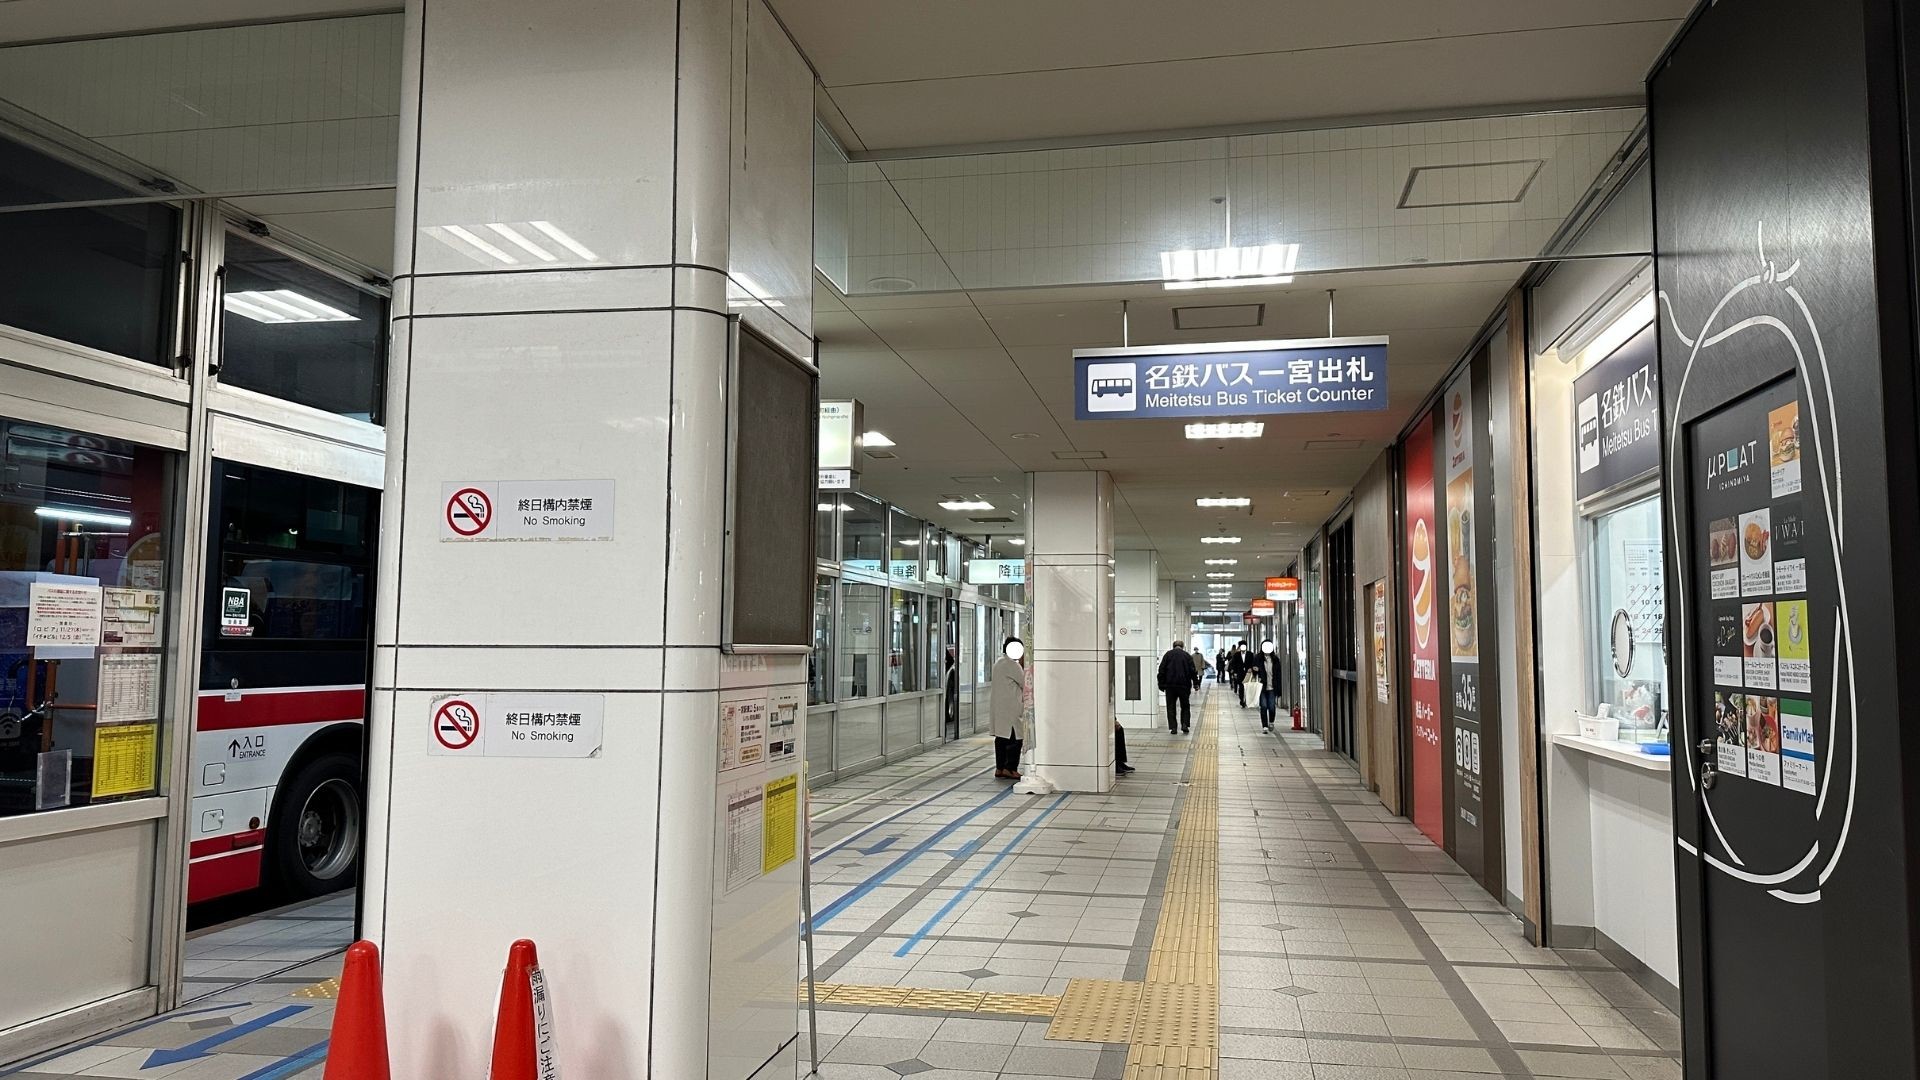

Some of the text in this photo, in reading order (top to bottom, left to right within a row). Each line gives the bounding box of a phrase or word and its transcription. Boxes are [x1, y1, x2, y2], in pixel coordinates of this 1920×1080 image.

[1145, 386, 1374, 408] Meitetsu Bus Ticket Counter
[1601, 364, 1657, 429] 名鉄バス
[1602, 425, 1633, 457] Meitetsu
[1634, 418, 1650, 442] Bus
[1719, 475, 1750, 491] ICHINOMIYA
[518, 498, 593, 512] 終日構内禁煙
[523, 515, 586, 527] No Smoking
[998, 564, 1025, 578] 降車
[228, 596, 245, 607] NBA
[505, 712, 581, 726] 終日構内禁煙
[511, 731, 574, 744] No Smoking
[1782, 725, 1813, 744] FamilyMar
[243, 735, 264, 749] 入口
[239, 749, 266, 759] ENTRANCE
